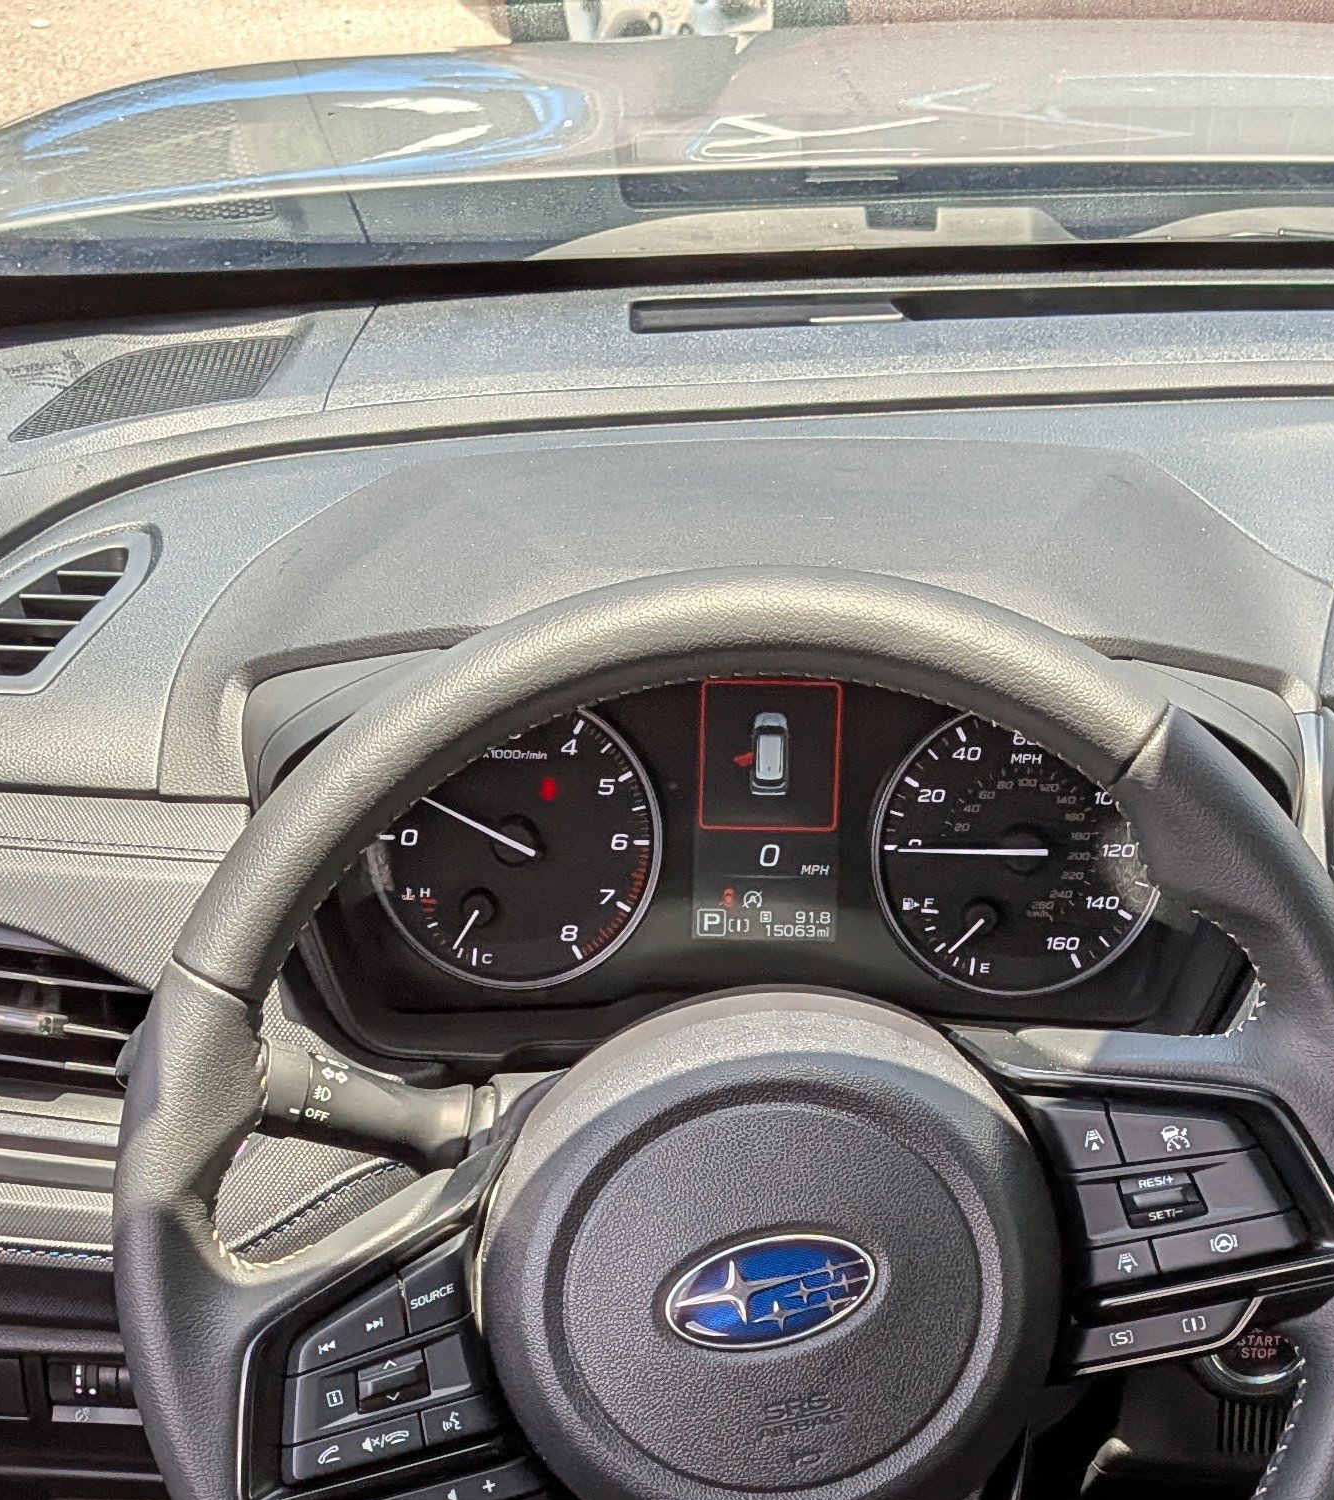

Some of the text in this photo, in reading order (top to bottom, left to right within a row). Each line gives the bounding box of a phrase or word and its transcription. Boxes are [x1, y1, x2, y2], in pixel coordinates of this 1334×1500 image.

[561, 739, 578, 756] 4
[952, 747, 981, 761] 40
[1010, 753, 1043, 765] MPH
[598, 779, 615, 795] 5
[997, 781, 1014, 790] 80
[917, 789, 945, 803] 20
[978, 791, 995, 800] 60
[963, 804, 981, 813] 40
[954, 822, 970, 832] 20
[401, 829, 418, 846] 0
[611, 834, 628, 851] 6
[759, 844, 780, 867] 0
[1102, 844, 1135, 858] 120
[800, 865, 830, 876] MPH
[420, 888, 431, 898] H
[599, 889, 615, 905] 7
[924, 898, 935, 909] F
[1085, 896, 1120, 910] 140
[795, 911, 831, 924] 91.8
[561, 925, 578, 942] 8
[1046, 936, 1080, 950] 160
[482, 954, 493, 964] C
[980, 963, 990, 973] E
[305, 1107, 330, 1121] OFF
[410, 1282, 455, 1310] SOURCE
[1241, 1347, 1277, 1360] STOP
